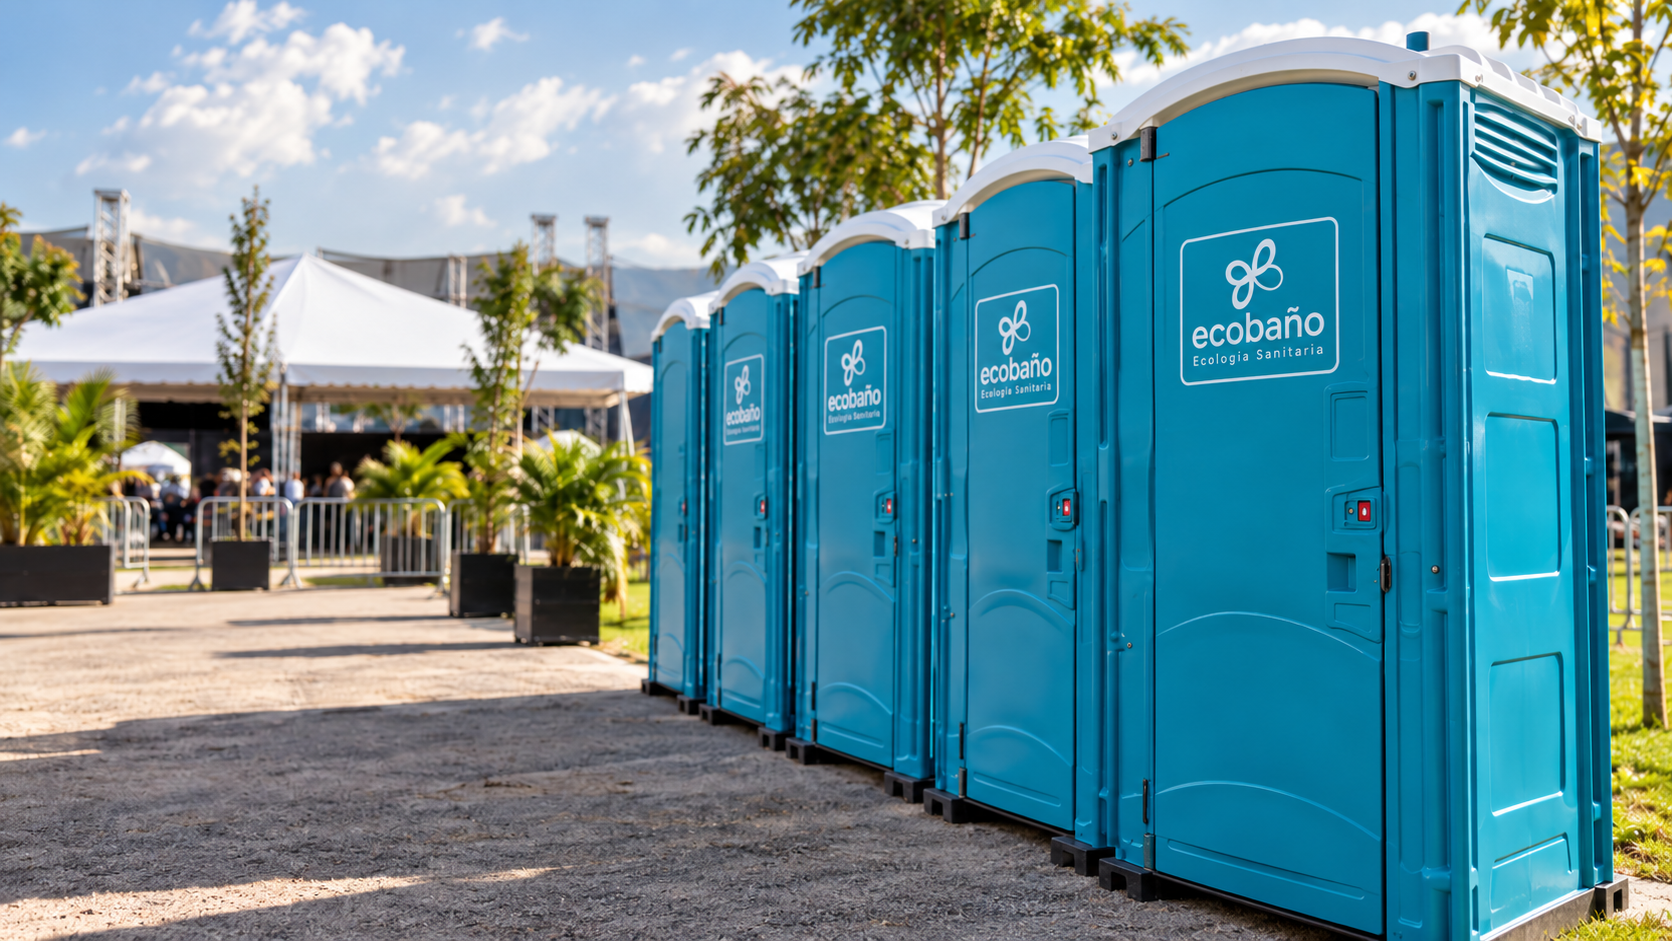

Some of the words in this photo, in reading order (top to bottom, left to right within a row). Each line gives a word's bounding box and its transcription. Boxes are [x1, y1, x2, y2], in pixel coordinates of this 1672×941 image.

[1192, 306, 1325, 349] ecobaño
[981, 353, 1052, 385] ecobaño
[1193, 351, 1249, 367] Ecologia
[1256, 344, 1324, 360] Sanitaria
[828, 384, 881, 412] ecobaño
[726, 403, 760, 426] ecobaño
